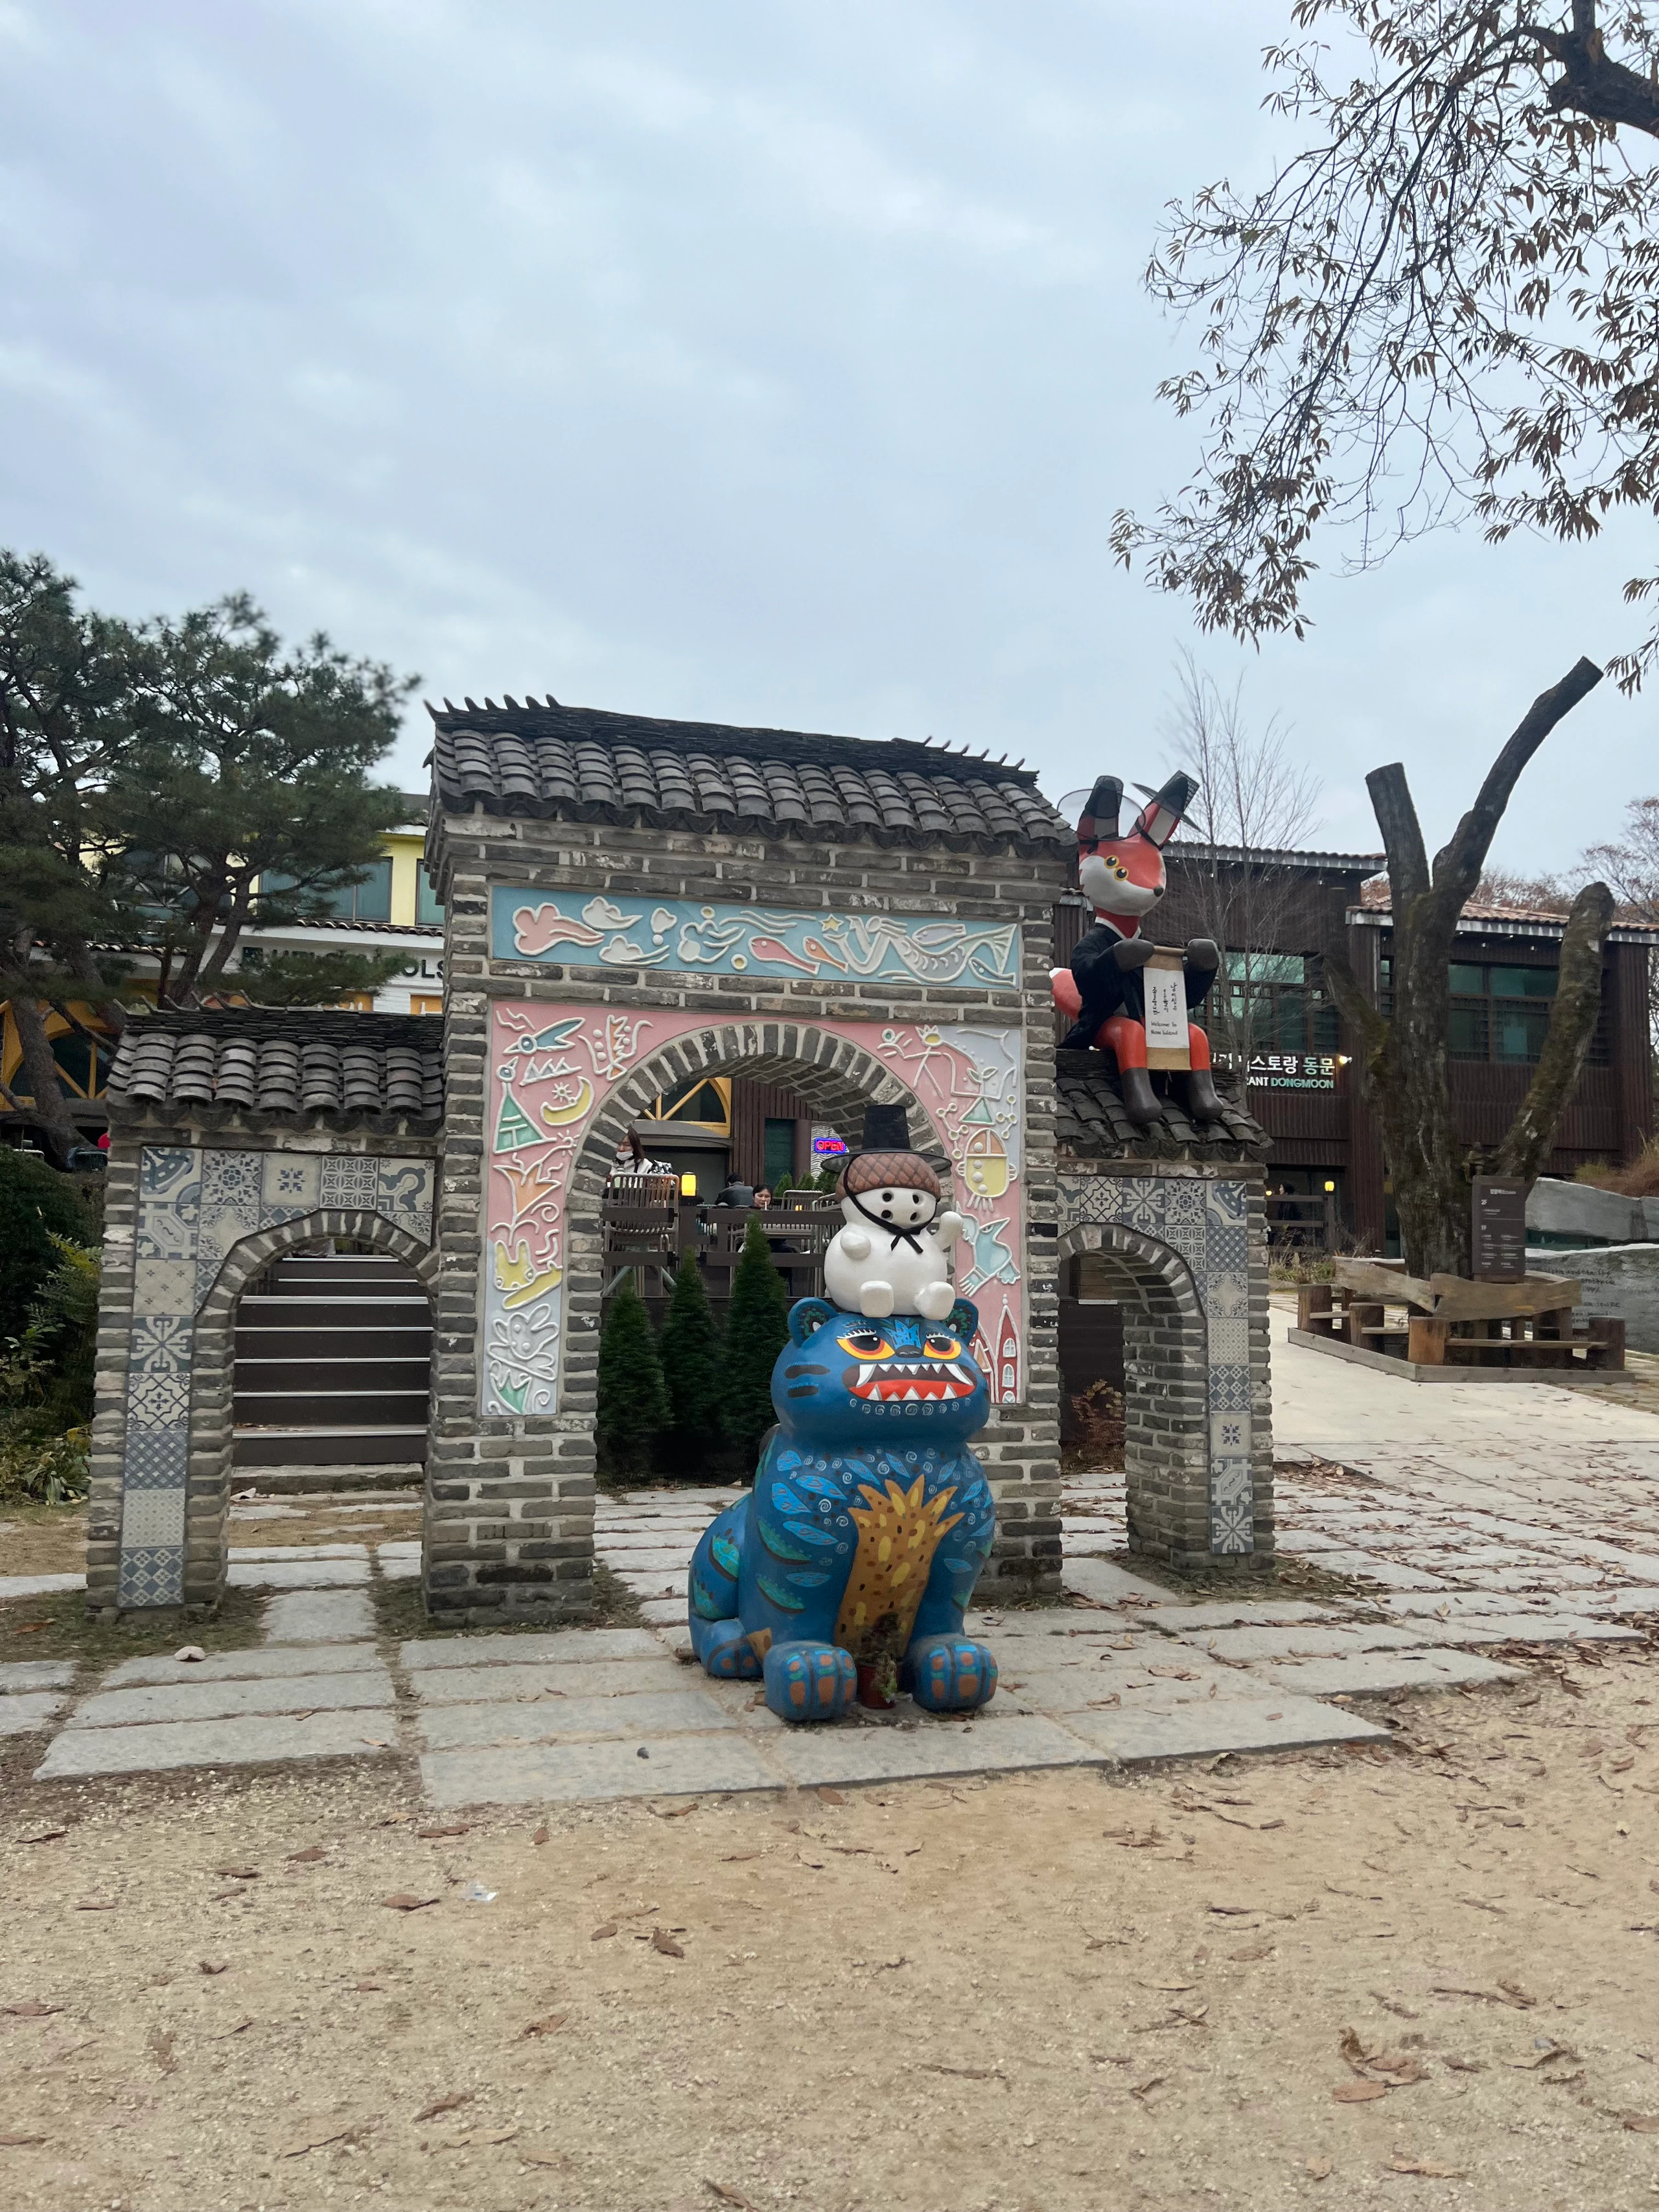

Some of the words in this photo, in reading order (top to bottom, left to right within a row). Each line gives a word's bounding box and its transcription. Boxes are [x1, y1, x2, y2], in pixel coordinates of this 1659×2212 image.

[1303, 1056, 1336, 1076] 동문
[1270, 1077, 1334, 1089] DONGMOON
[817, 1140, 844, 1151] OPEN
